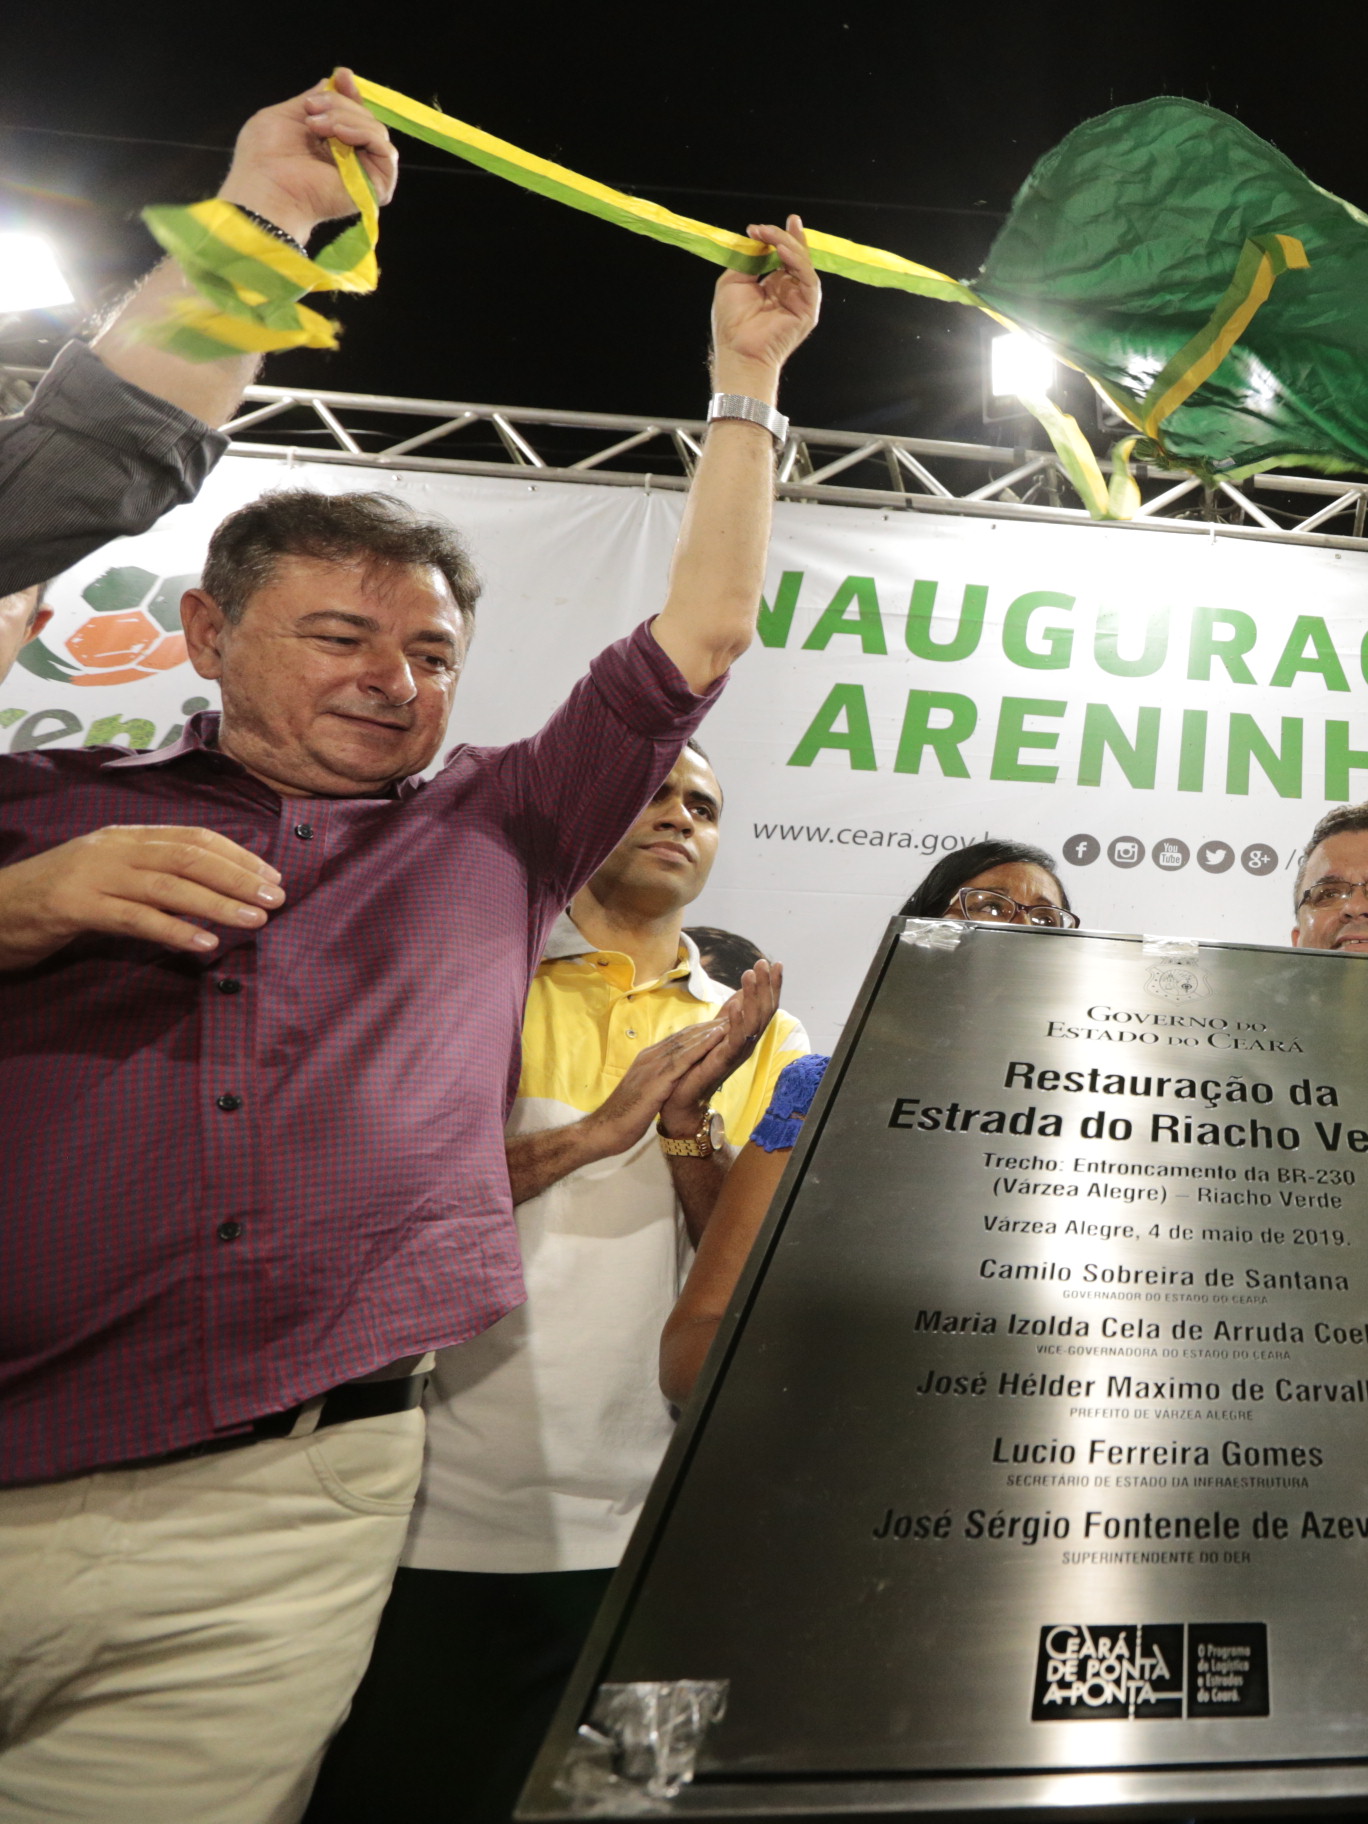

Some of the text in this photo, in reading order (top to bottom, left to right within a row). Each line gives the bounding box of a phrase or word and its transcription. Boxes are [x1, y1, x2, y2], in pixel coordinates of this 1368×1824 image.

[753, 822, 989, 855] www.ceara.gov
[1003, 1061, 1339, 1109] Restauração da
[887, 1097, 1063, 1138] Estrada
[1080, 1111, 1133, 1142] do
[1150, 1113, 1300, 1151] Riacho
[982, 1152, 1356, 1186] Trecho: Entroncamento da BR-230
[993, 1176, 1079, 1198] (Várzea
[1087, 1182, 1168, 1204] Alegre)
[1198, 1187, 1272, 1207] Riacho
[1279, 1191, 1342, 1209] Verde
[983, 1215, 1351, 1247] Várzea Alegre, 4 de maio de 2019.
[979, 1258, 1349, 1292] Camilo Sobreira de Santana
[1063, 1289, 1141, 1301] GOVERNADOR
[1145, 1293, 1161, 1301] DO
[1165, 1293, 1209, 1303] ESTADO
[1212, 1295, 1228, 1304] DO
[913, 1309, 997, 1336] Maria
[1007, 1312, 1090, 1338] Izolda
[1101, 1316, 1160, 1340] Cela
[1171, 1318, 1203, 1342] de
[1213, 1320, 1304, 1344] Arruda
[1036, 1345, 1158, 1358] VICE-GOVERNADORA
[1162, 1348, 1178, 1358] DO
[1183, 1349, 1228, 1359] ESTADO
[1233, 1350, 1249, 1360] DO
[916, 1370, 987, 1396] José
[998, 1371, 1096, 1398] Hélder
[1106, 1375, 1220, 1401] Maximo
[1231, 1378, 1265, 1402] de
[1069, 1407, 1129, 1419] PREFEITO
[1133, 1408, 1150, 1419] DE
[1206, 1409, 1254, 1421] ALEGRE
[992, 1437, 1324, 1468] Lucio Ferreira Gomes
[1094, 1476, 1110, 1488] DE
[1116, 1476, 1167, 1488] ESTADO
[1172, 1477, 1188, 1488] DA
[1194, 1477, 1309, 1489] INFRAESTRUTURA
[873, 1508, 952, 1540] José
[964, 1508, 1071, 1545] Sérgio
[1083, 1510, 1240, 1539] Fontenele
[1252, 1510, 1289, 1540] de
[1062, 1551, 1251, 1565] SUPERINTENDENTE DO DER
[1046, 1626, 1130, 1660] CEARÁ
[1047, 1645, 1170, 1682] DE PONTA
